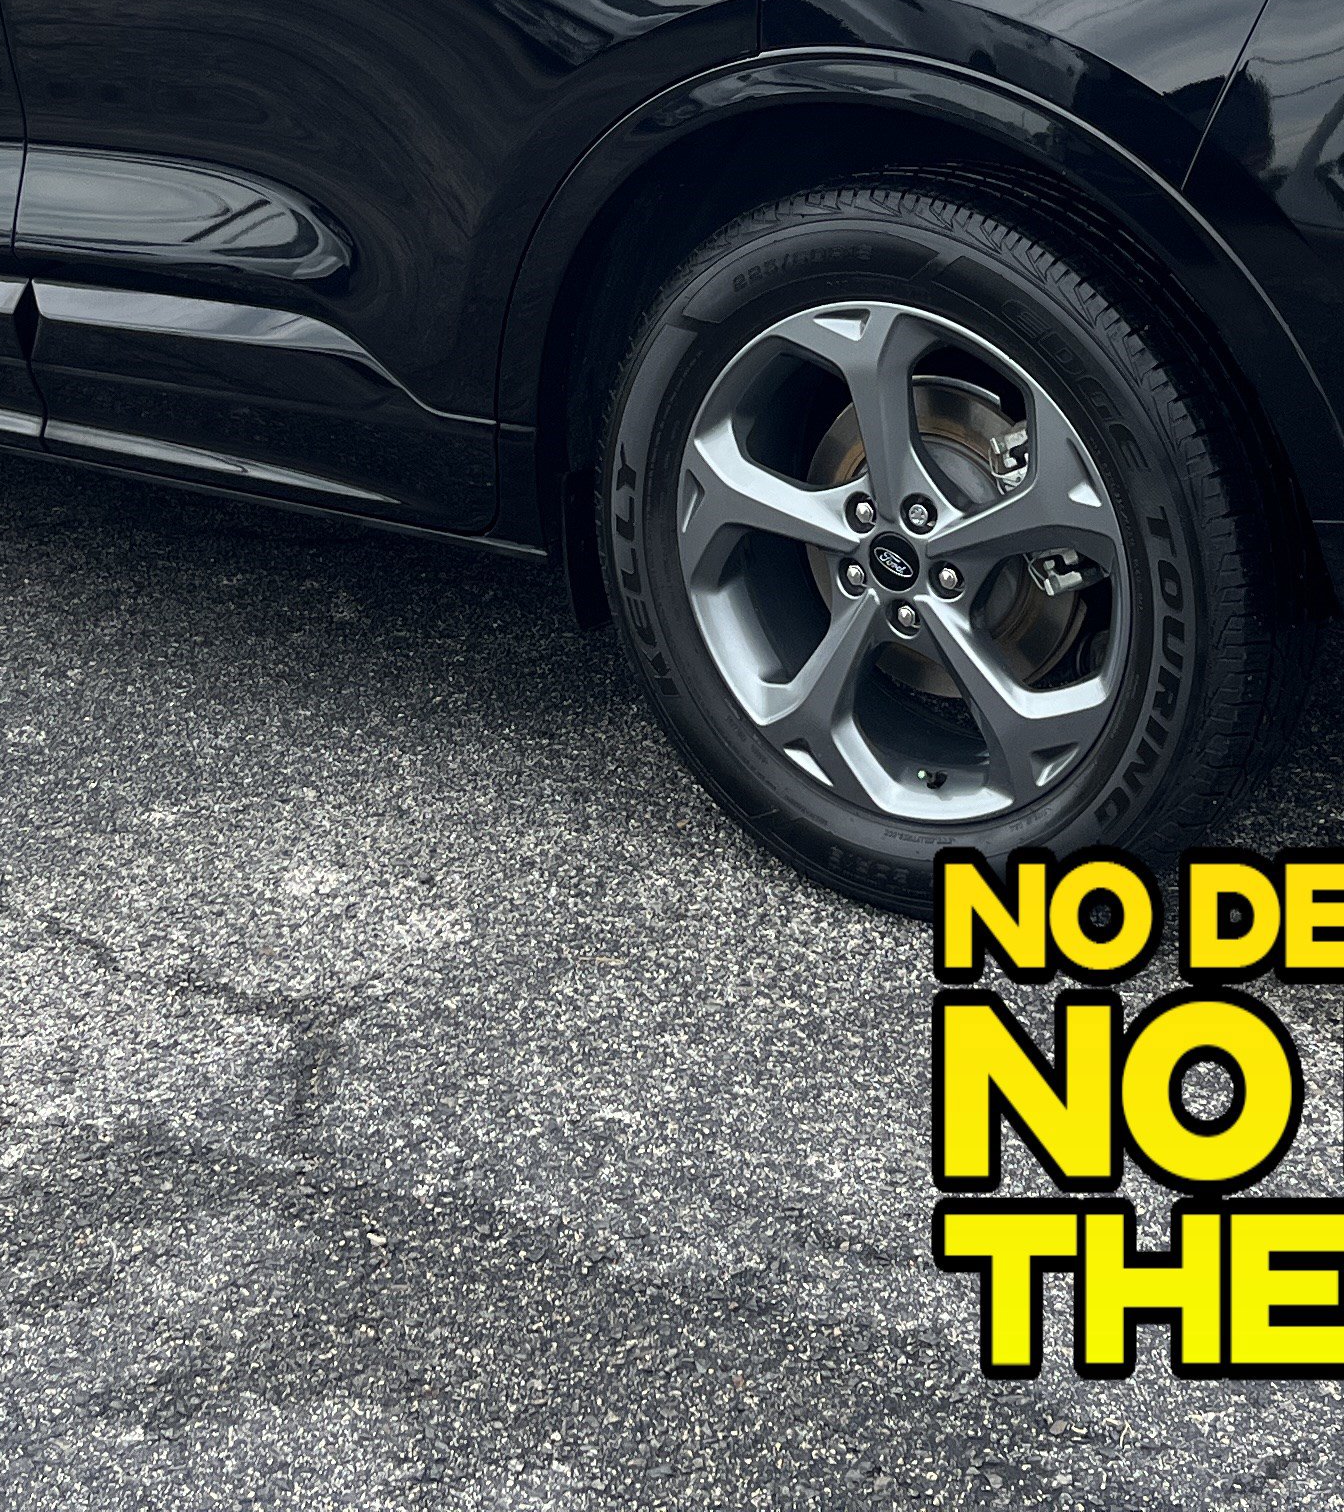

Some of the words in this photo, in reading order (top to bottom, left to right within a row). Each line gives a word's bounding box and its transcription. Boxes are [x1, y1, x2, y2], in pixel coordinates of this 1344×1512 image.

[1001, 299, 1151, 471] EDGE
[614, 440, 680, 698] KELLY
[879, 551, 907, 575] Ford
[1093, 505, 1186, 828] TOURING
